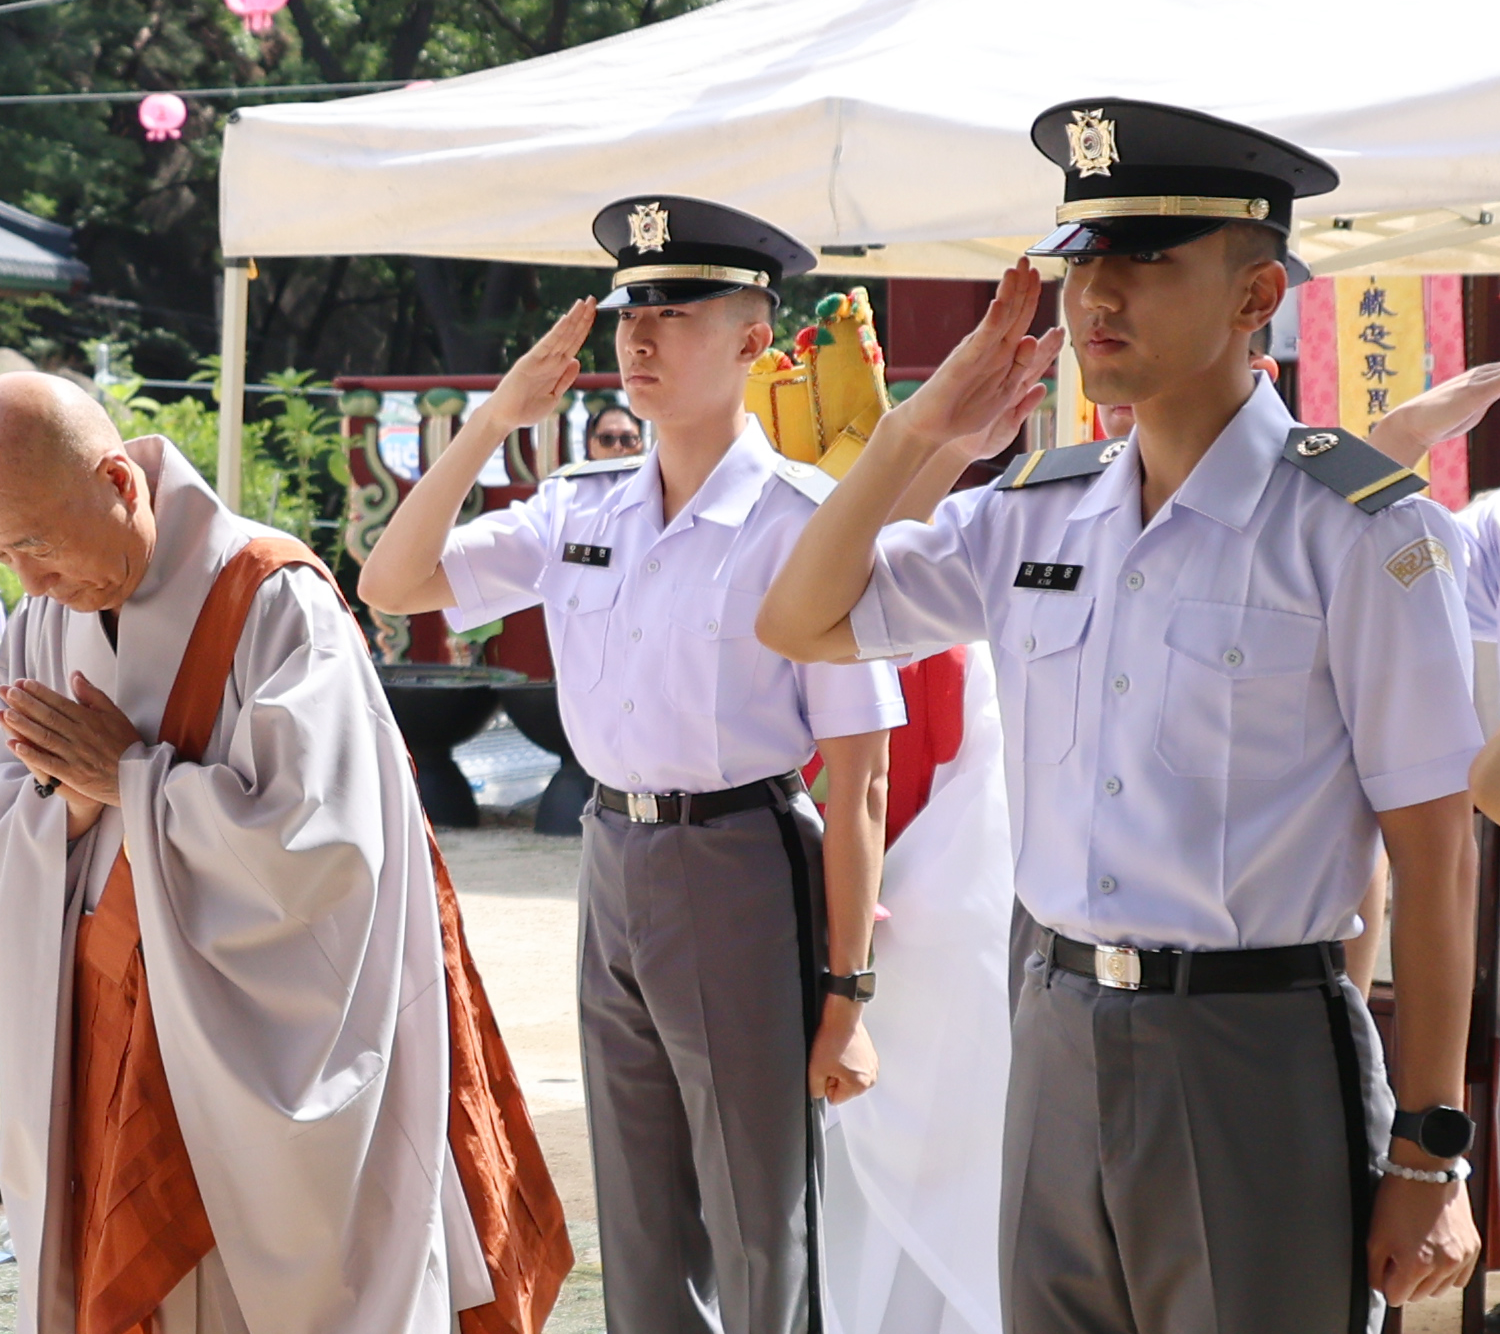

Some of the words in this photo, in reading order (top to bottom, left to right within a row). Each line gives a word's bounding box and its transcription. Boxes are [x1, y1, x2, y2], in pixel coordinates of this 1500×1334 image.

[1359, 275, 1398, 437] 藏世界毘
[1037, 578, 1052, 586] KIM
